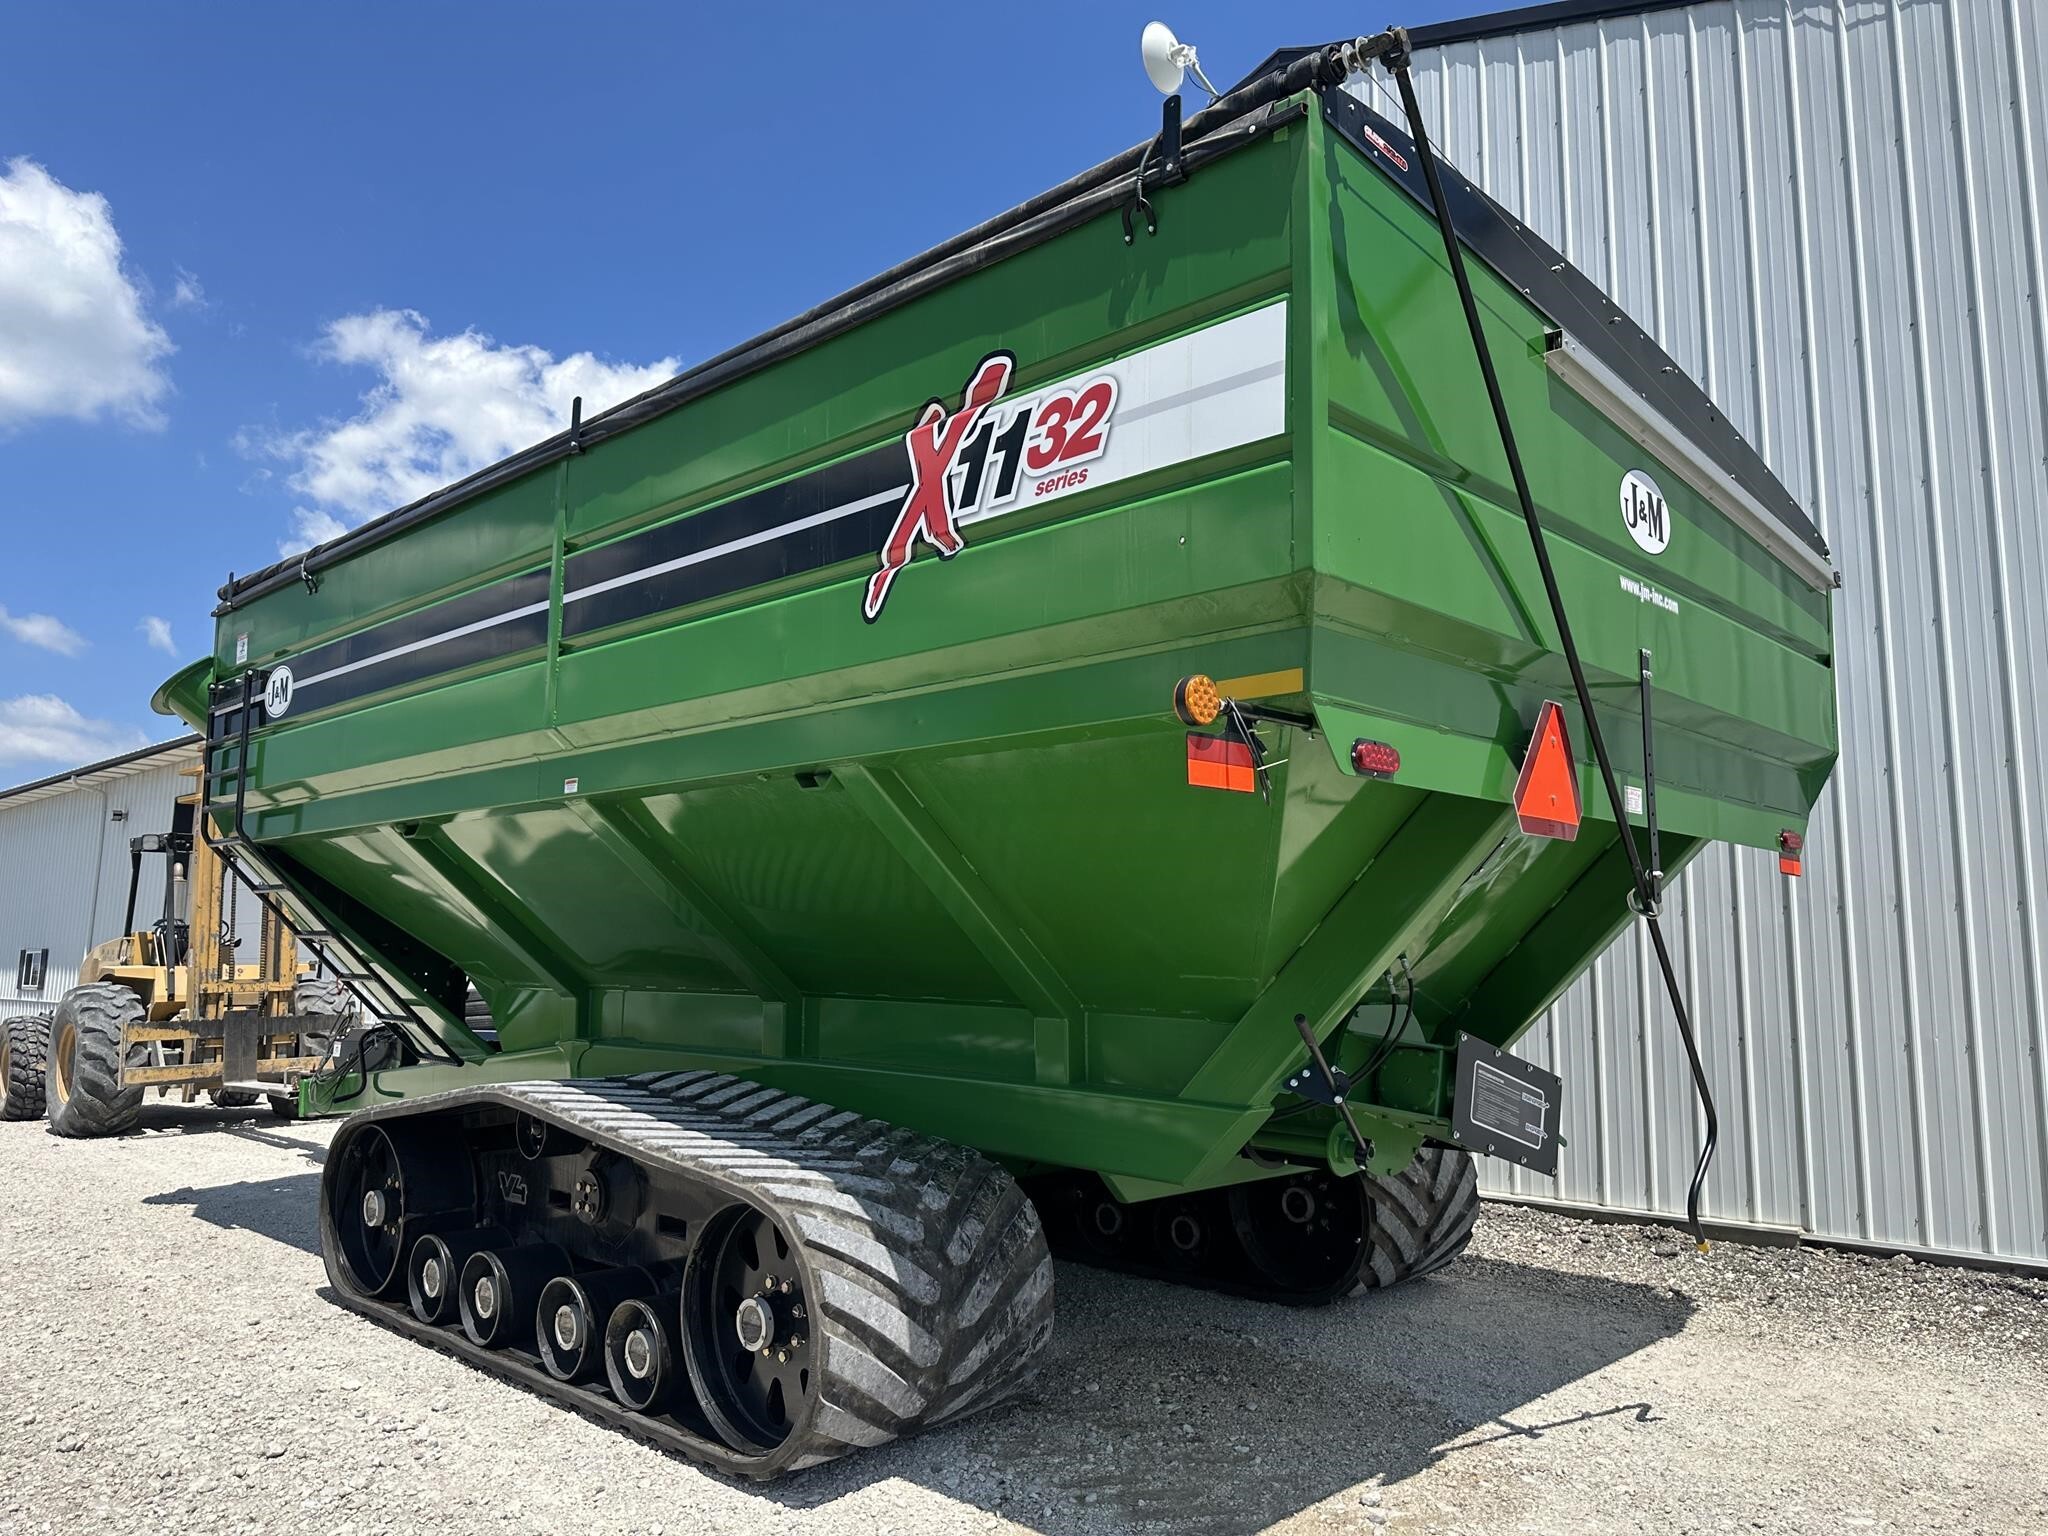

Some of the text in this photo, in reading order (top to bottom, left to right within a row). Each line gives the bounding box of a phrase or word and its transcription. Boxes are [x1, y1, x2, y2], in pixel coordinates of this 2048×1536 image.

[1034, 466, 1089, 497] series
[1624, 482, 1664, 544] J&M
[1619, 575, 1679, 614] www.jm-inc.com
[268, 676, 289, 708] J&M
